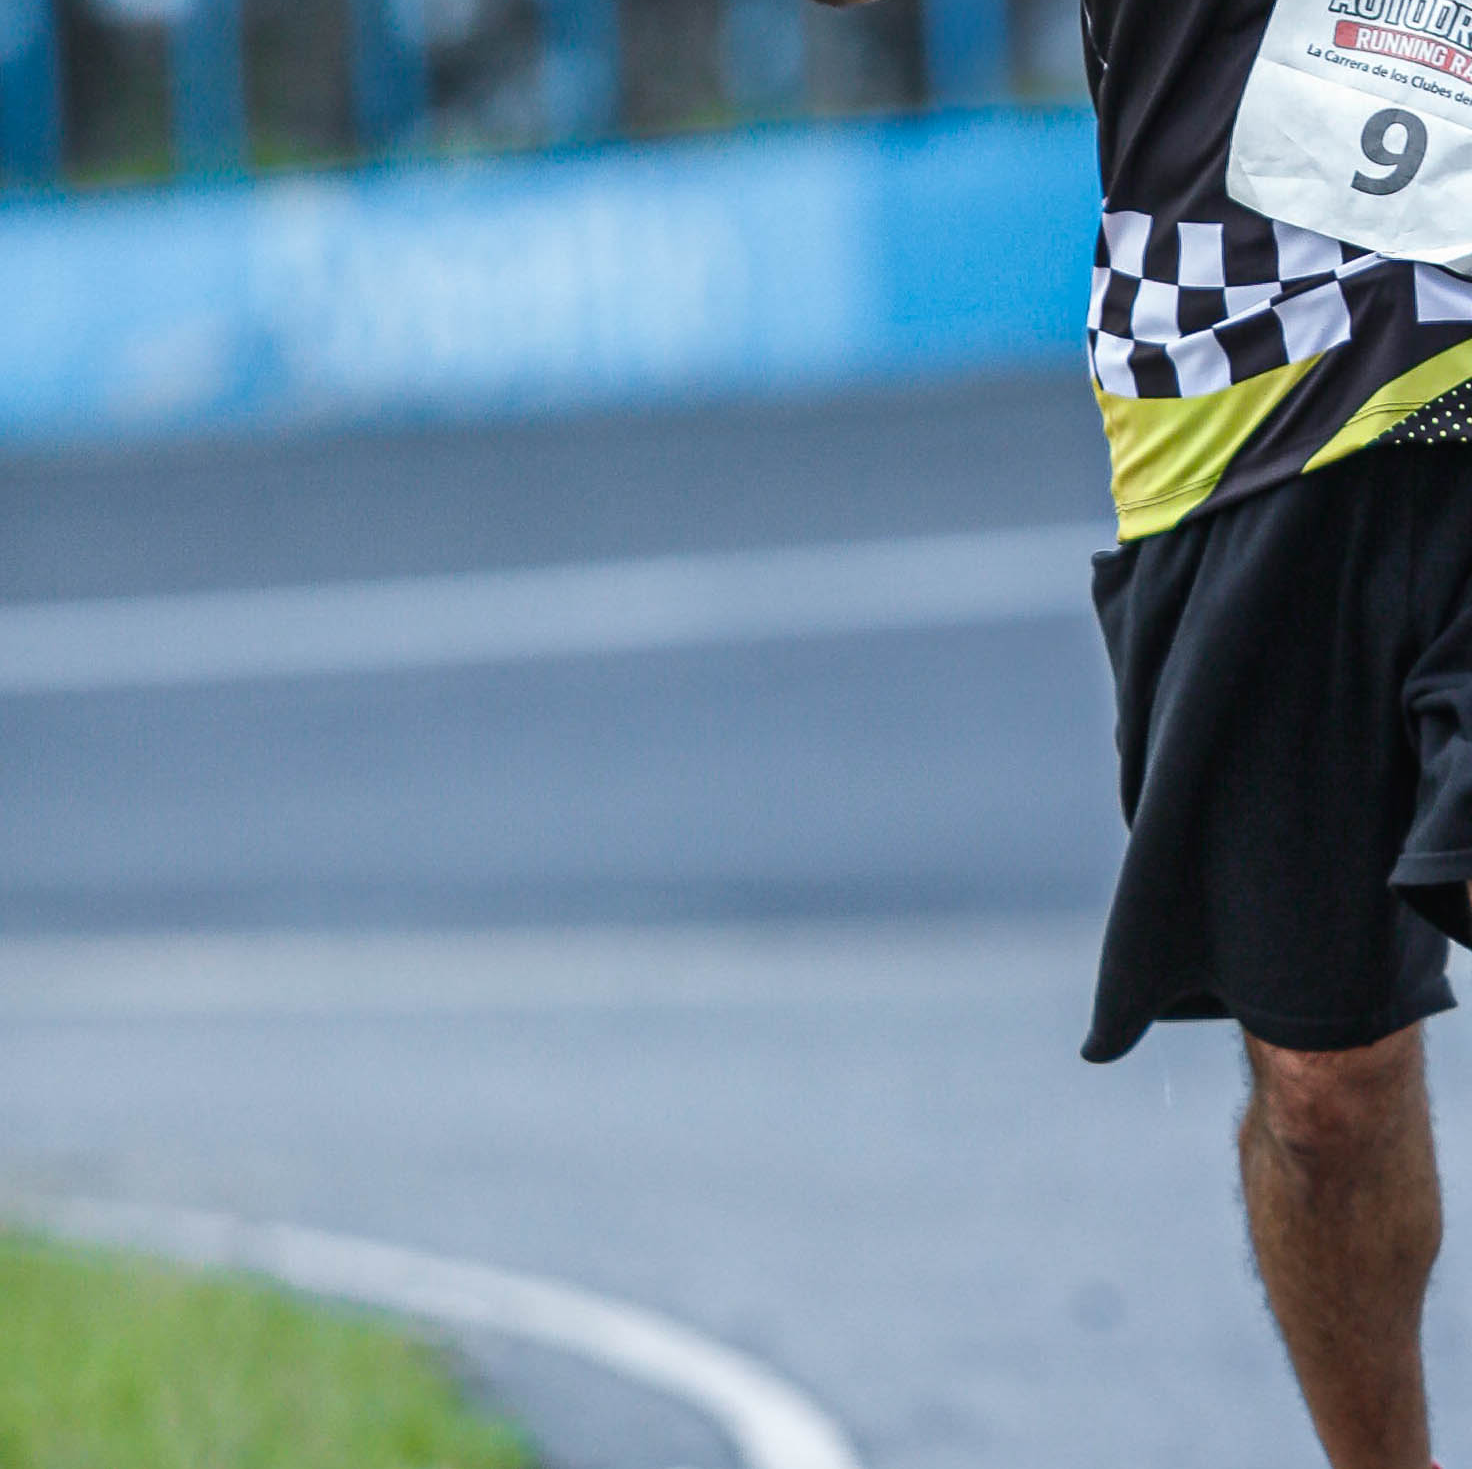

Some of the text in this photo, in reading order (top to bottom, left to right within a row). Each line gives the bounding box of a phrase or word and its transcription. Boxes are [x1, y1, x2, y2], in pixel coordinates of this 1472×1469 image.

[1307, 43, 1322, 57] La
[1324, 49, 1370, 72] Carrera
[1371, 64, 1389, 78] de
[1390, 68, 1409, 84] los
[1411, 76, 1452, 98] Clubes
[1356, 27, 1447, 67] RUNNING
[1350, 108, 1429, 196] 9
